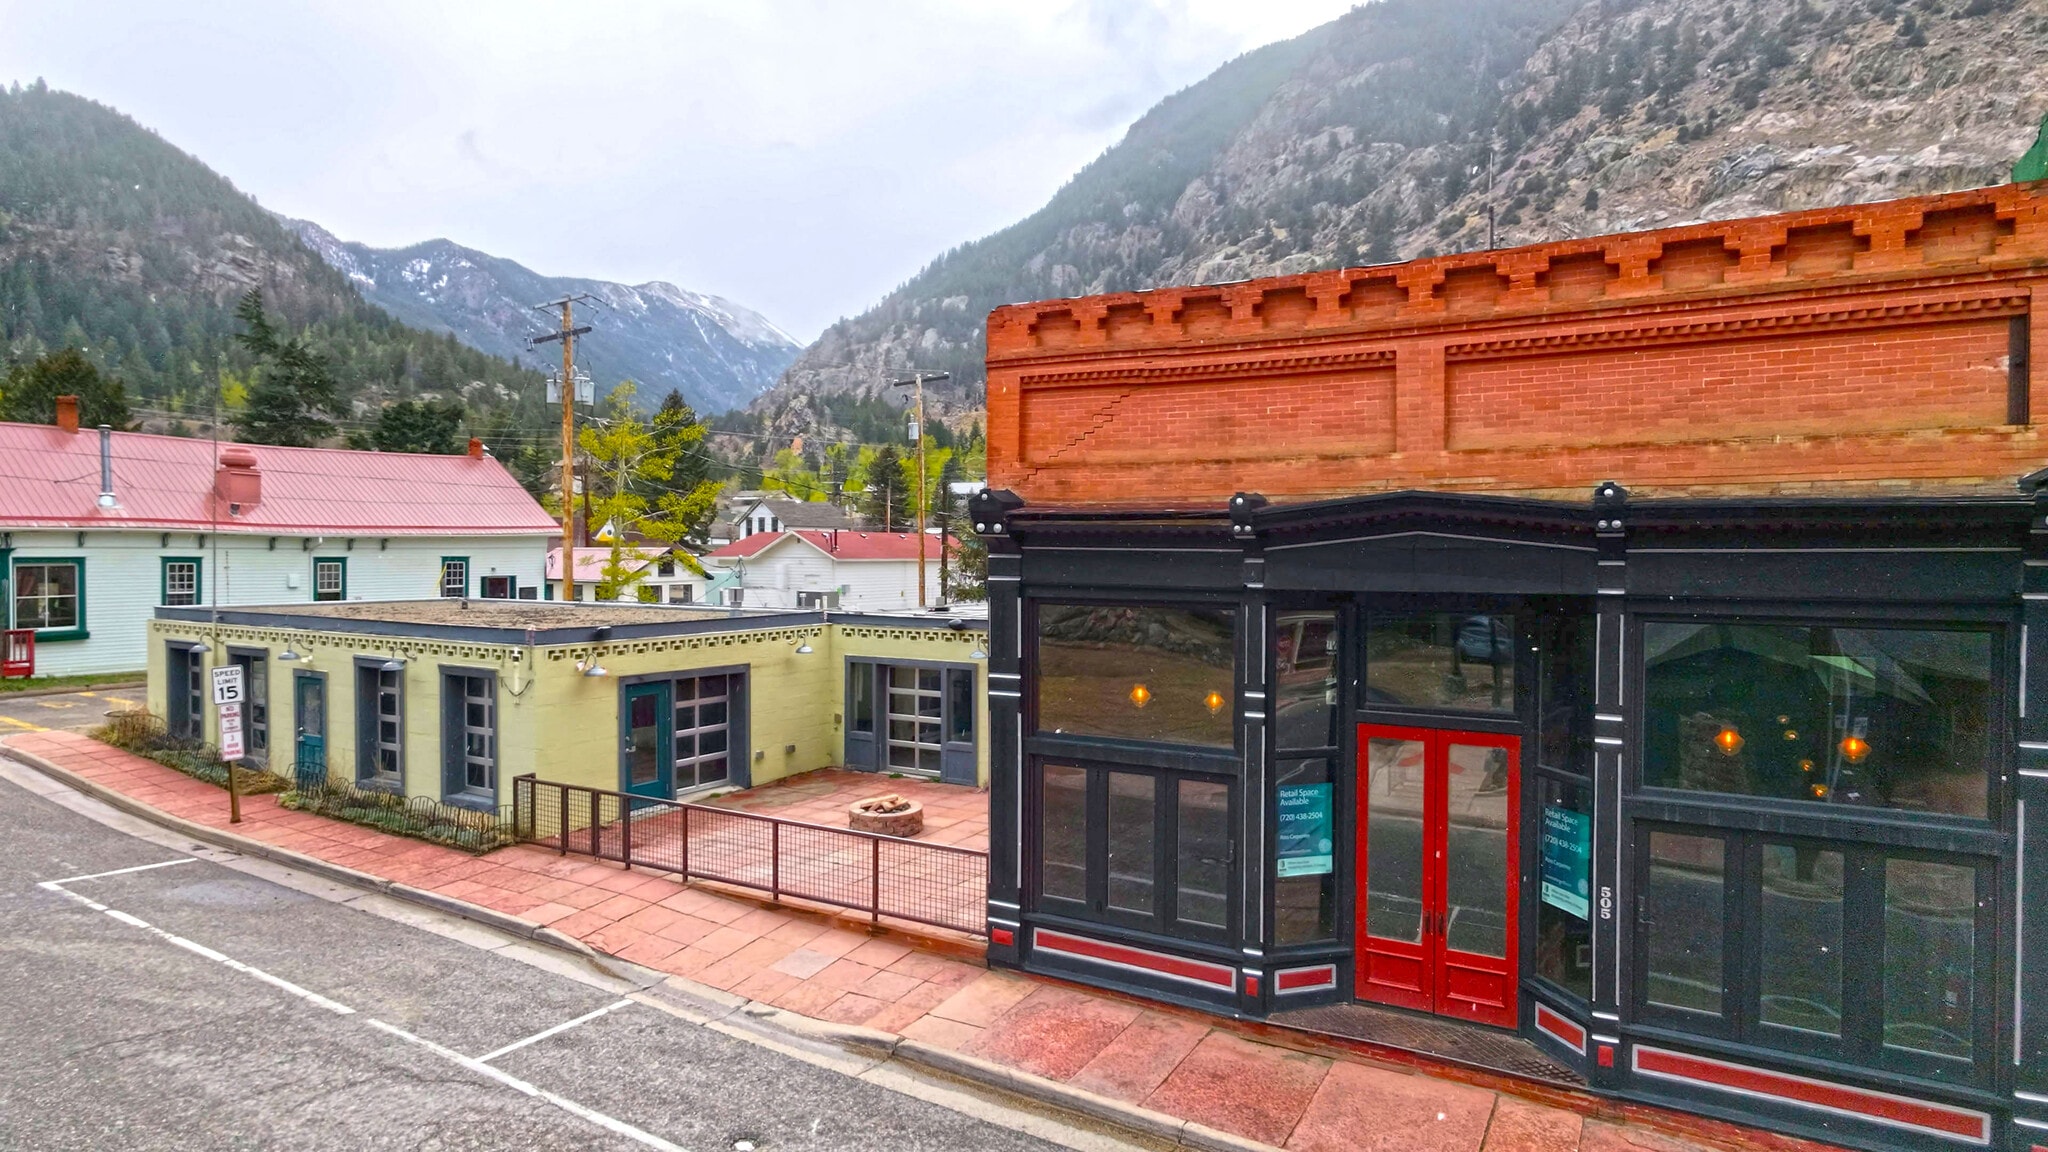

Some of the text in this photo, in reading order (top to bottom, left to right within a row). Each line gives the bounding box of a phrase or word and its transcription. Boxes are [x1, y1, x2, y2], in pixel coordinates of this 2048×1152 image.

[214, 669, 241, 678] SPEED
[217, 677, 238, 685] LIMIT
[218, 685, 239, 701] 15
[1280, 788, 1319, 800] Retail Space
[1280, 797, 1309, 806] Available
[1280, 811, 1323, 822] (720) 438-2504
[1545, 807, 1578, 826] Retail Space
[1545, 817, 1571, 833] Available
[1545, 834, 1559, 846] (720)
[1600, 886, 1612, 920] 505
